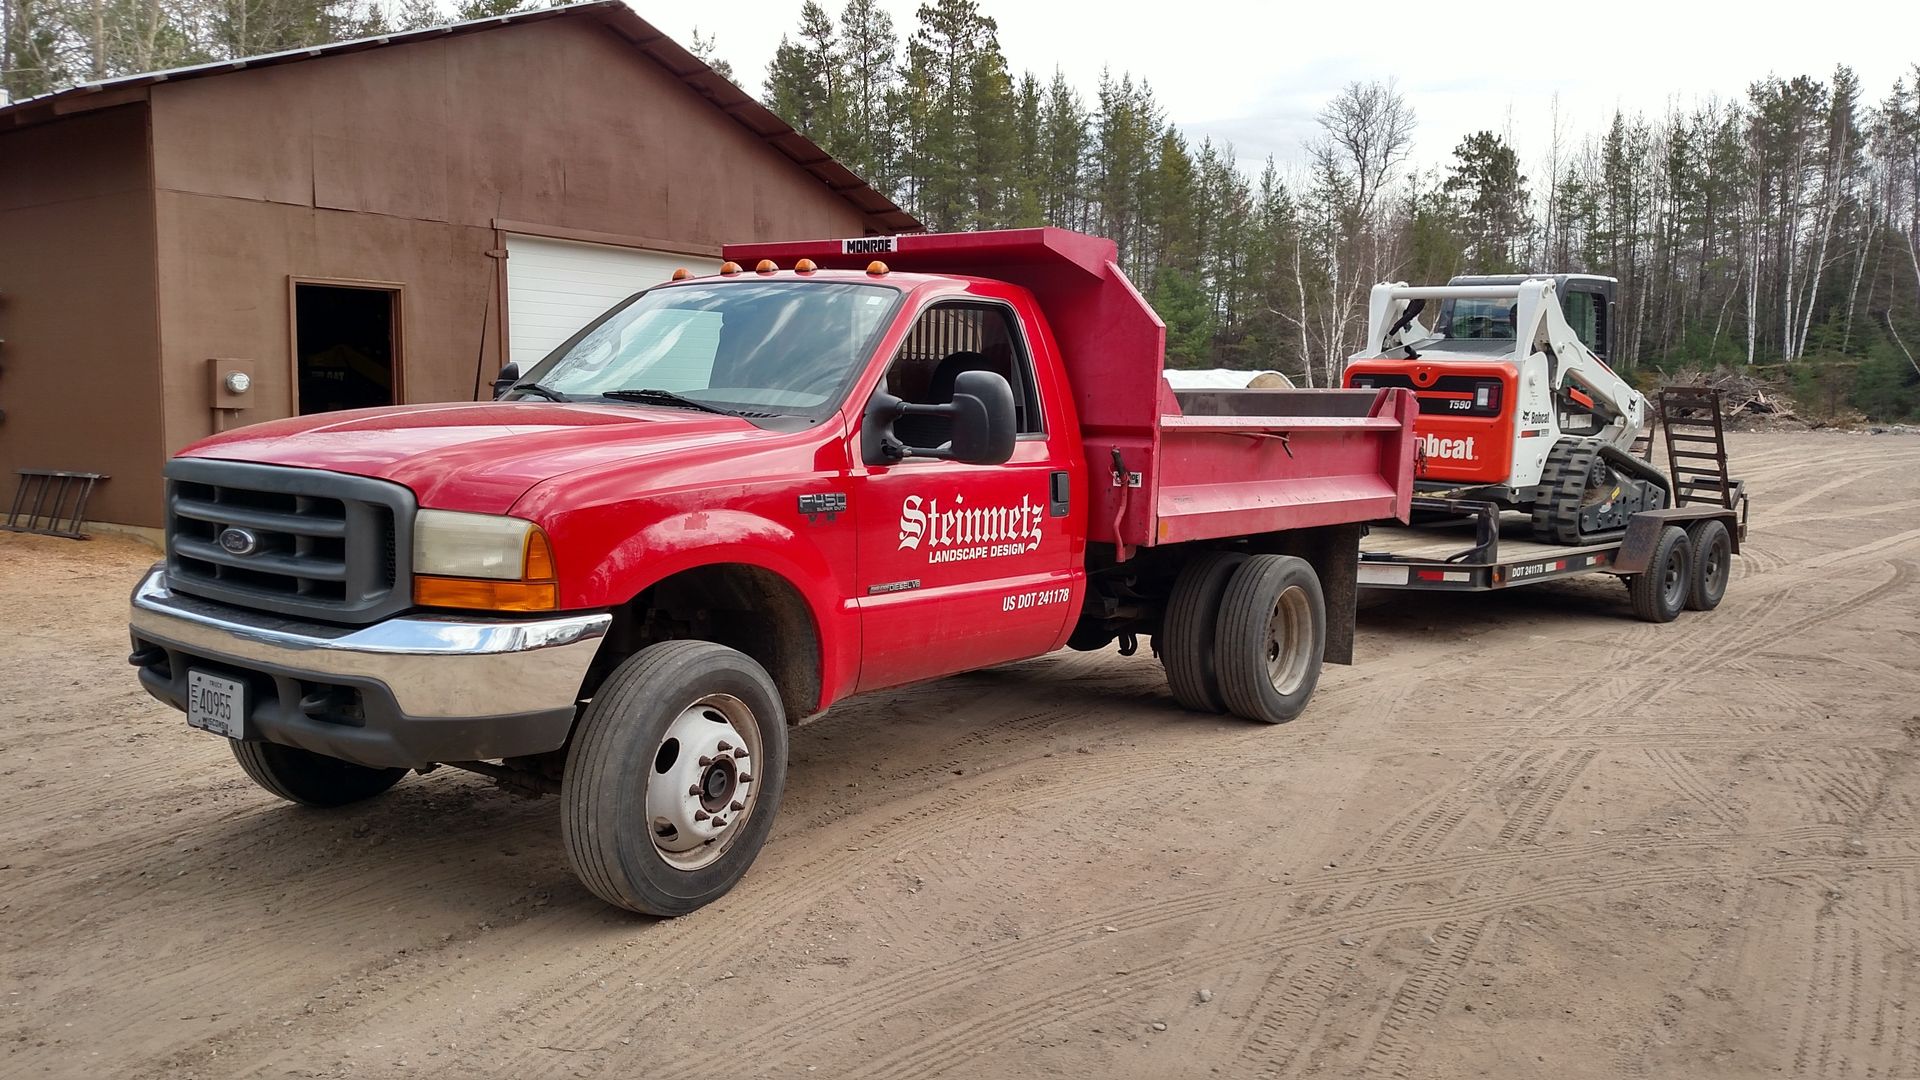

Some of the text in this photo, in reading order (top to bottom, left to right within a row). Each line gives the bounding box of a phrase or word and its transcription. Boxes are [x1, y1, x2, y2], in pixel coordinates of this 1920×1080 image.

[846, 239, 892, 254] MONROE
[1449, 400, 1472, 410] T590
[898, 493, 1045, 551] Steinmetz
[928, 543, 1025, 564] LANDSCAPE DESIGN
[1512, 563, 1544, 578] DOT 241178
[1003, 587, 1070, 612] US DOT 241178
[200, 688, 232, 720] 40955
